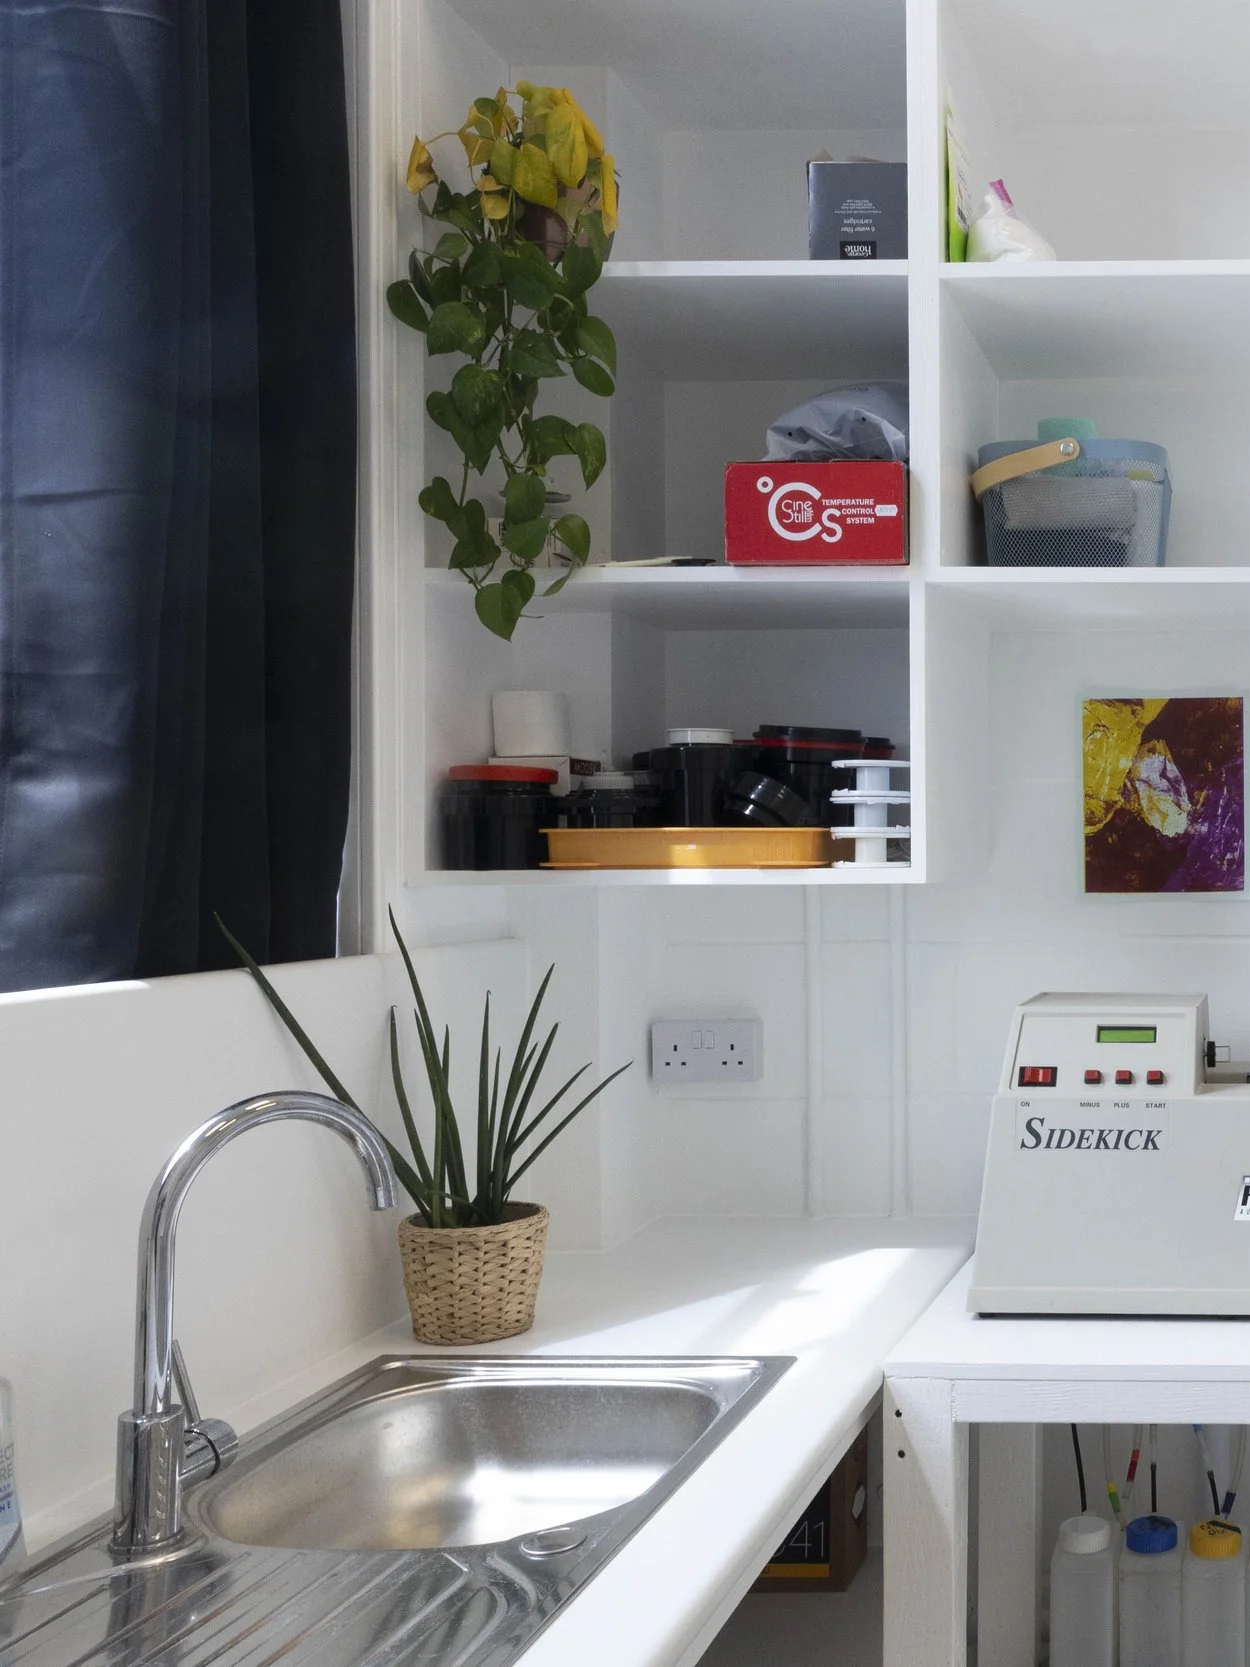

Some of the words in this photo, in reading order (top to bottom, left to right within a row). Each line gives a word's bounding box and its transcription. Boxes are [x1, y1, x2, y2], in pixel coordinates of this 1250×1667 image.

[844, 245, 872, 256] home
[781, 499, 812, 510] Cine
[821, 498, 875, 506] TEMPERATURE
[846, 517, 875, 525] SYSTEM
[1020, 1116, 1163, 1151] SIDEKICK
[773, 1520, 824, 1558] 41
